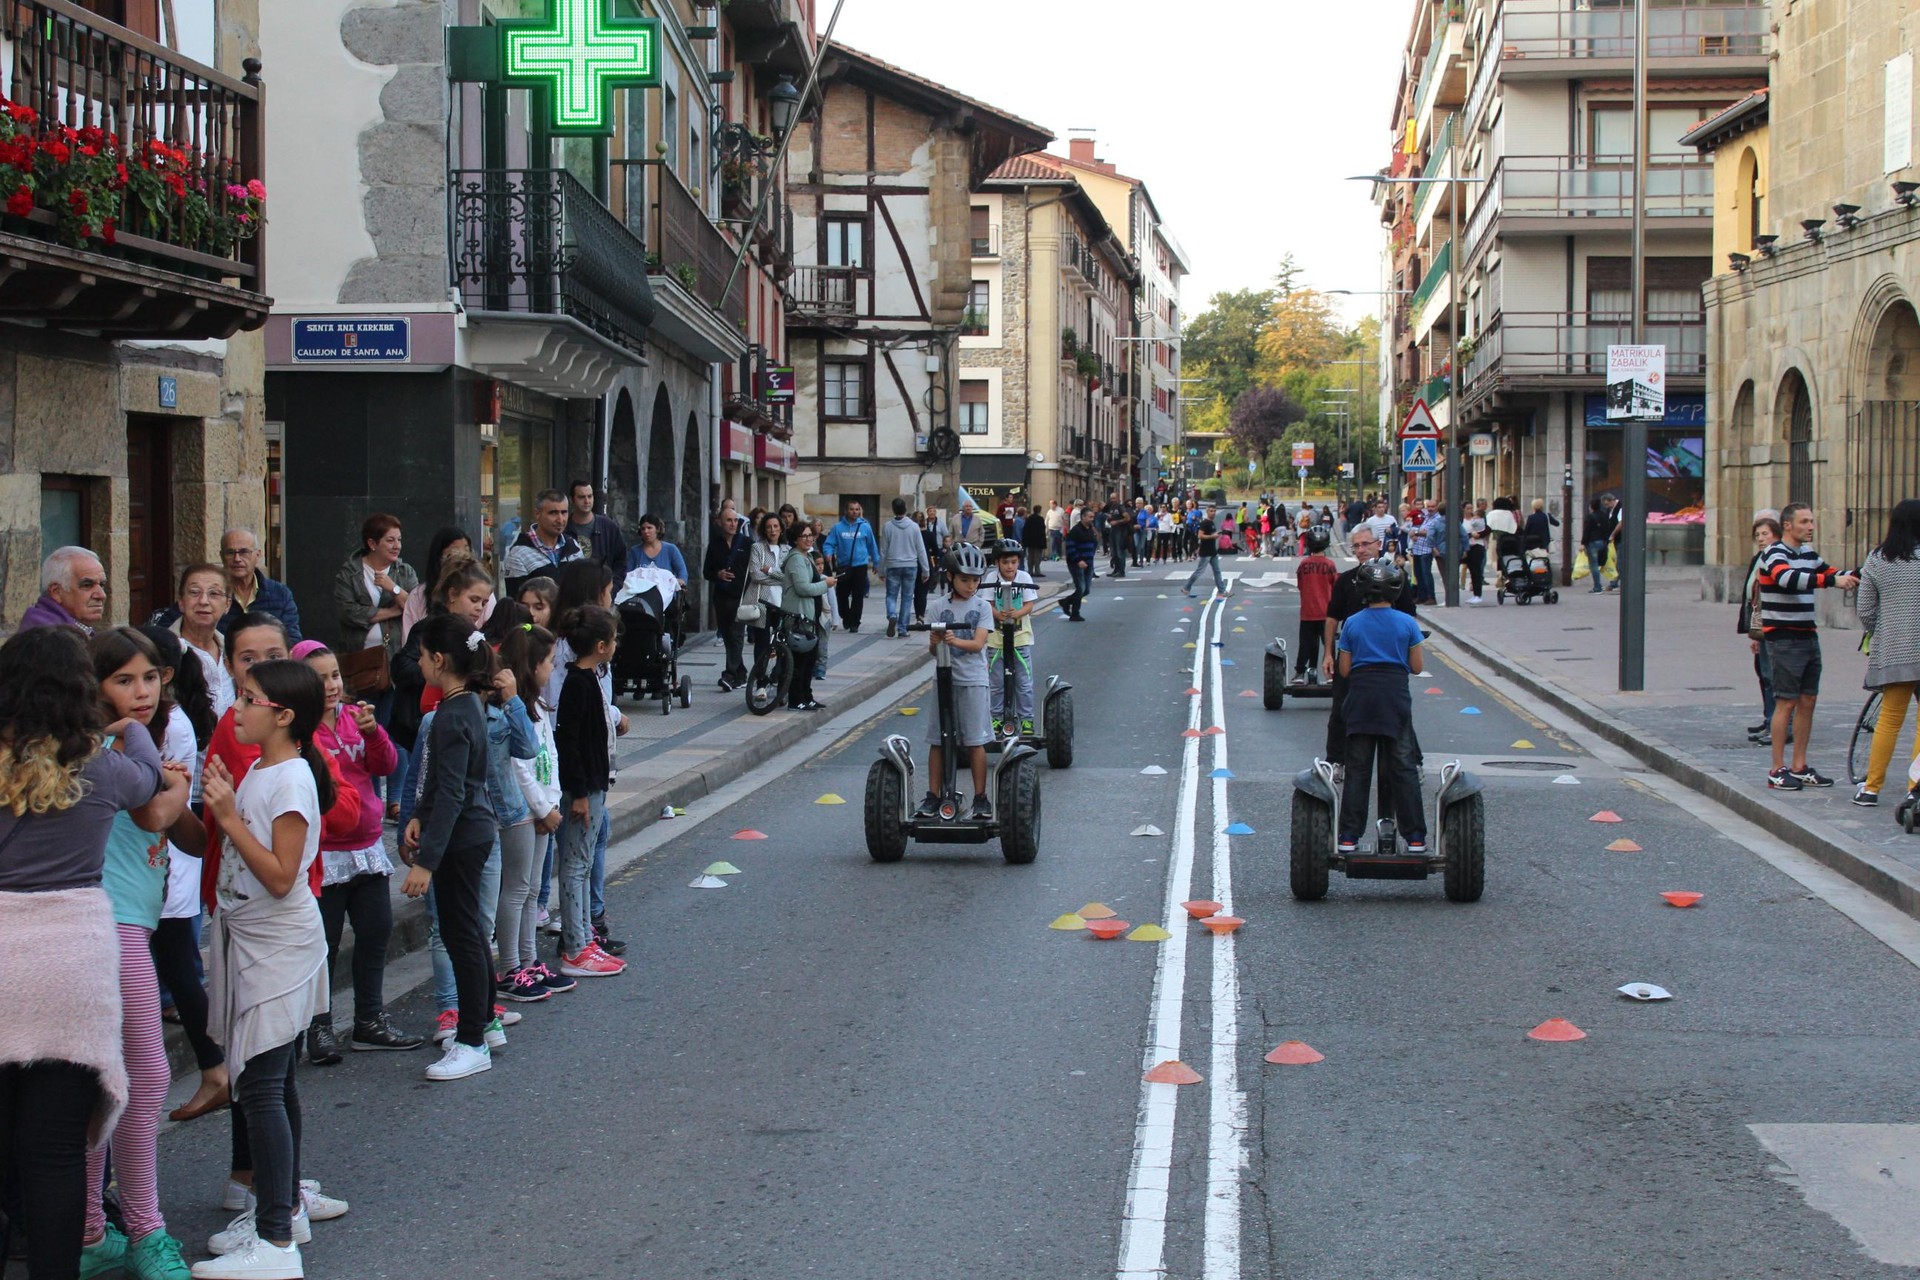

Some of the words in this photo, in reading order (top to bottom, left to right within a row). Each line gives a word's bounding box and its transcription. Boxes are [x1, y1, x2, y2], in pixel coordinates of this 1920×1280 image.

[306, 324, 334, 332] SANTA
[337, 324, 354, 332] ANA
[357, 324, 395, 332] KARKABA
[297, 348, 337, 356] CALLEJON
[341, 348, 351, 356] DE
[354, 348, 380, 356] SANTA
[385, 348, 404, 356] ANA
[1611, 349, 1661, 358] MATRIKULA
[1611, 358, 1648, 367] ZABALIK
[163, 382, 175, 402] 26
[967, 487, 995, 496] ETXEA
